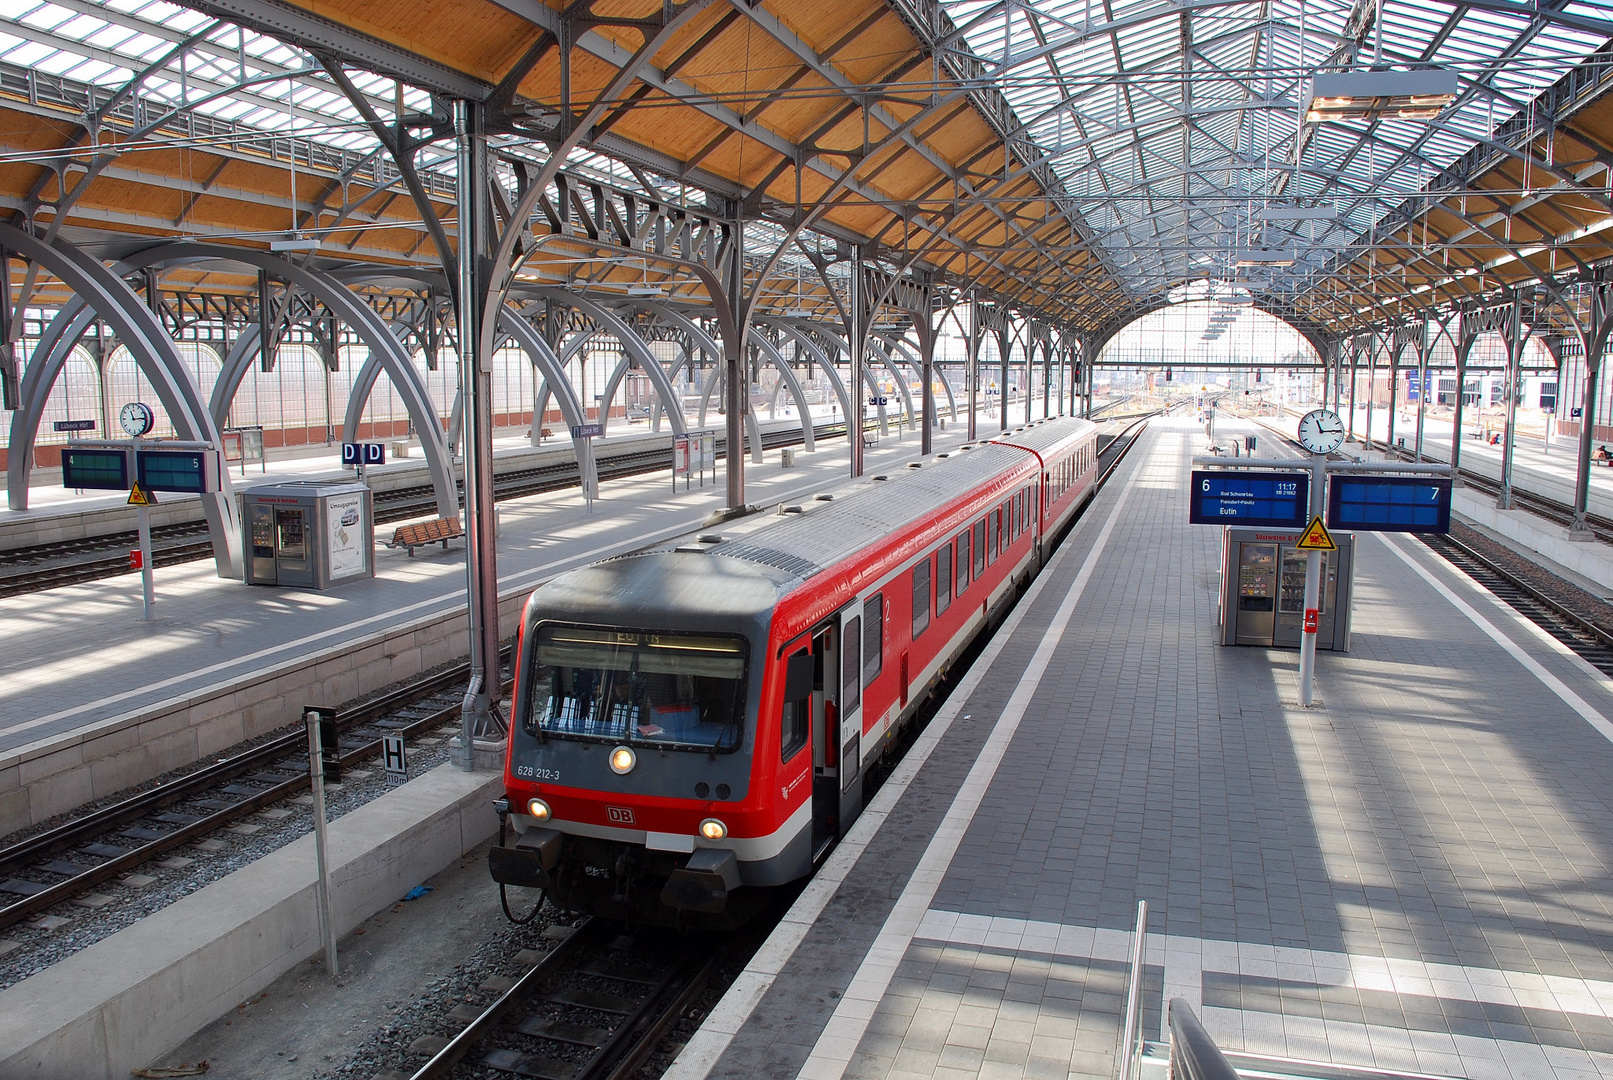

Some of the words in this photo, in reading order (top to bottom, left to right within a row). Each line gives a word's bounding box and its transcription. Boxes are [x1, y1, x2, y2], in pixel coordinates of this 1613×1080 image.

[344, 444, 355, 460] D
[369, 444, 380, 460] D
[69, 455, 74, 465] 4
[193, 458, 199, 468] 5
[1202, 479, 1211, 492] 6
[1277, 483, 1297, 491] 11:17
[1431, 487, 1440, 500] 7
[1220, 507, 1237, 515] Eutin
[885, 600, 890, 622] 2
[385, 738, 403, 770] H
[387, 774, 399, 784] 110
[517, 765, 534, 777] 628
[536, 768, 560, 780] 212-3
[608, 807, 632, 822] DB
